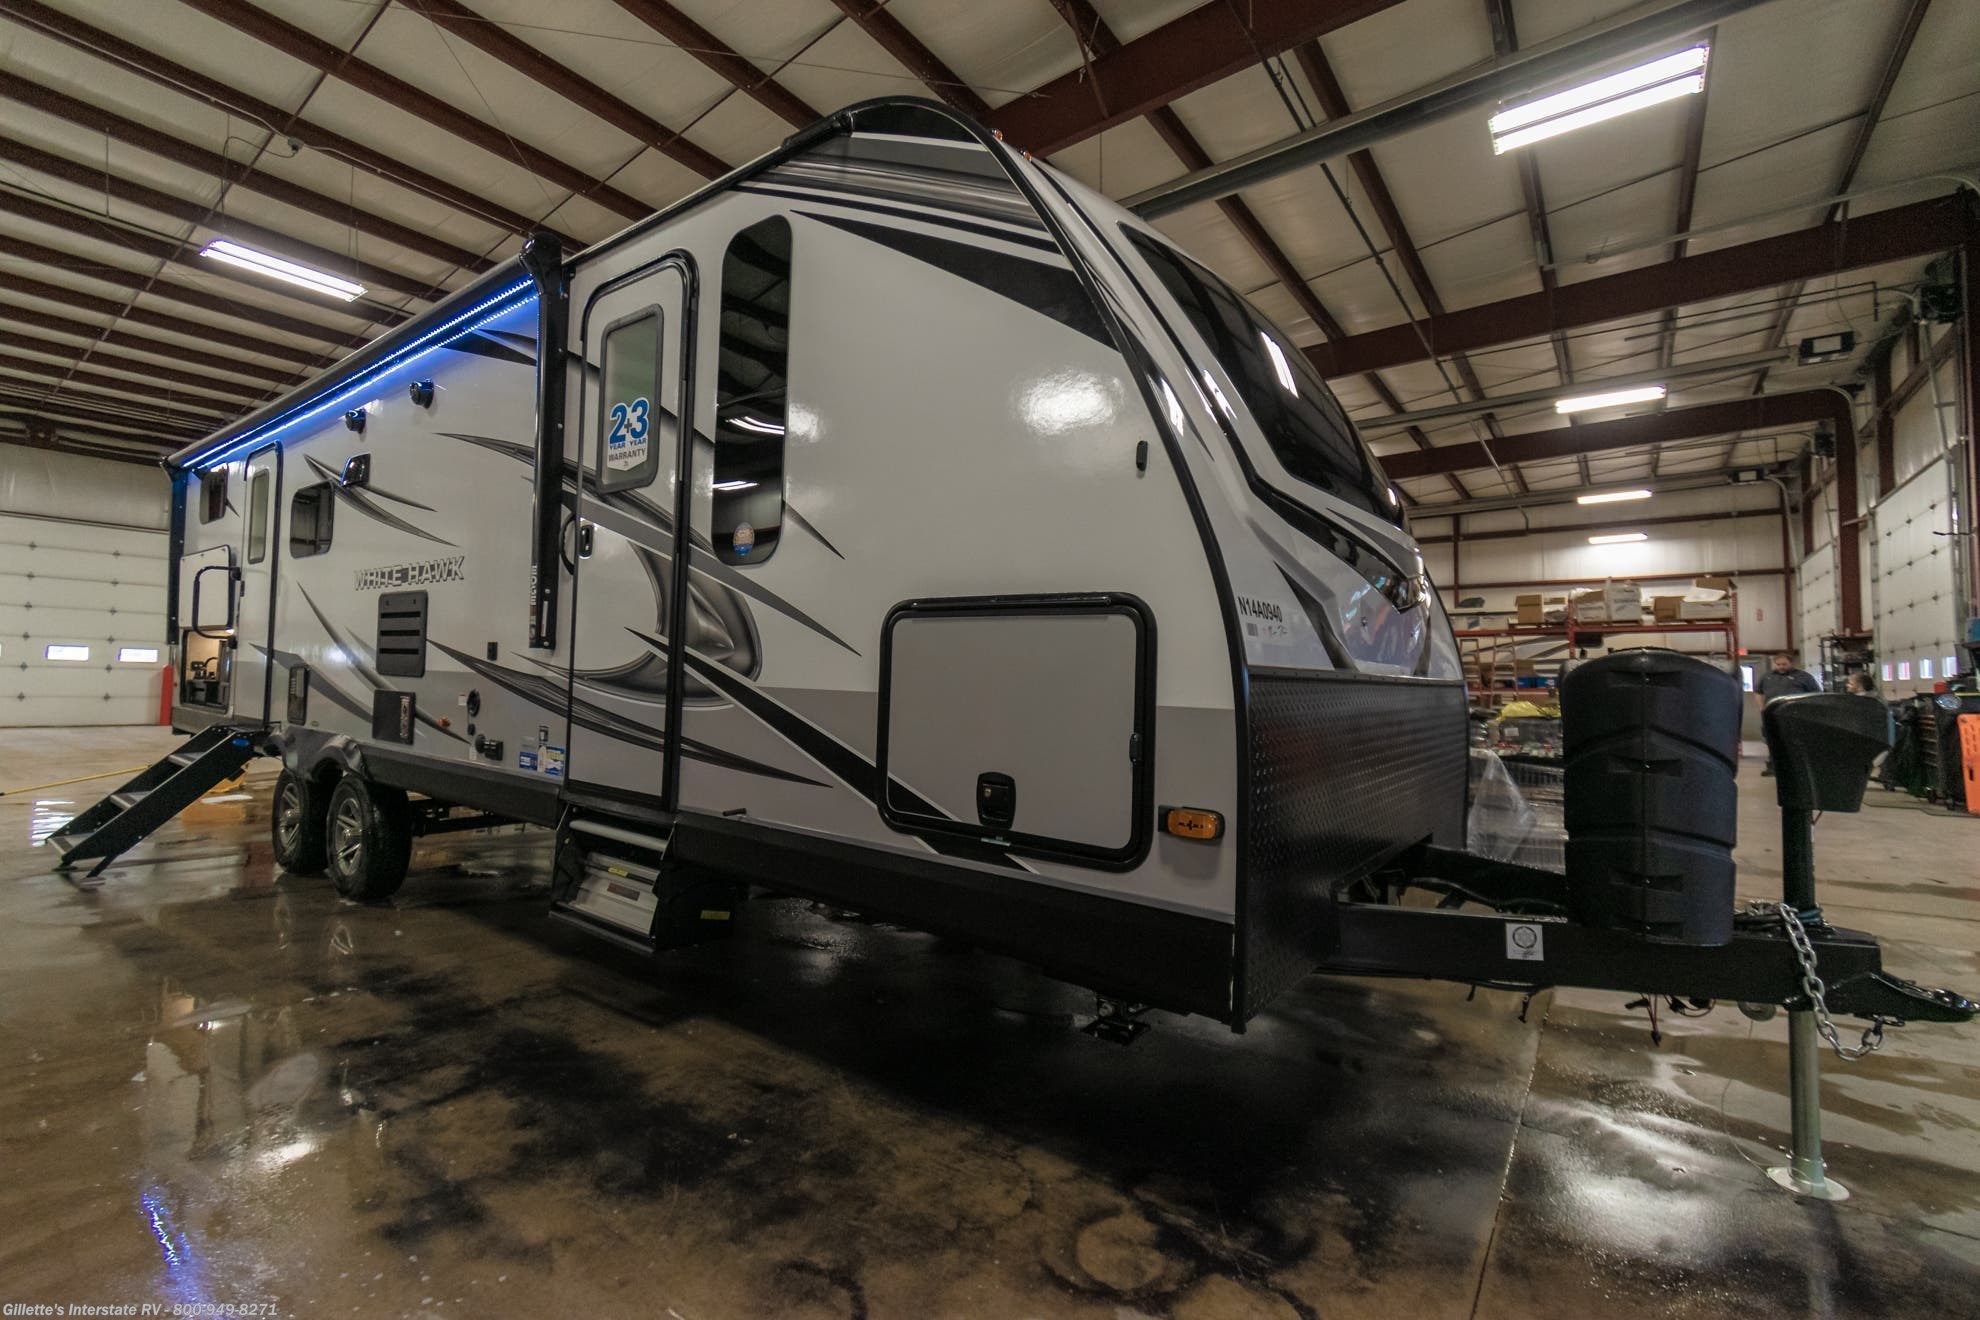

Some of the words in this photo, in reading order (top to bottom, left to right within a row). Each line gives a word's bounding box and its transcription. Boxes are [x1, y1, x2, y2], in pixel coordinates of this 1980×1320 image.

[610, 442, 626, 450] YEAR
[630, 438, 647, 446] YEAR
[608, 448, 647, 461] WARRANTY
[353, 565, 403, 591] WHITE
[408, 555, 465, 585] HAWK
[1238, 596, 1283, 623] N14A0940
